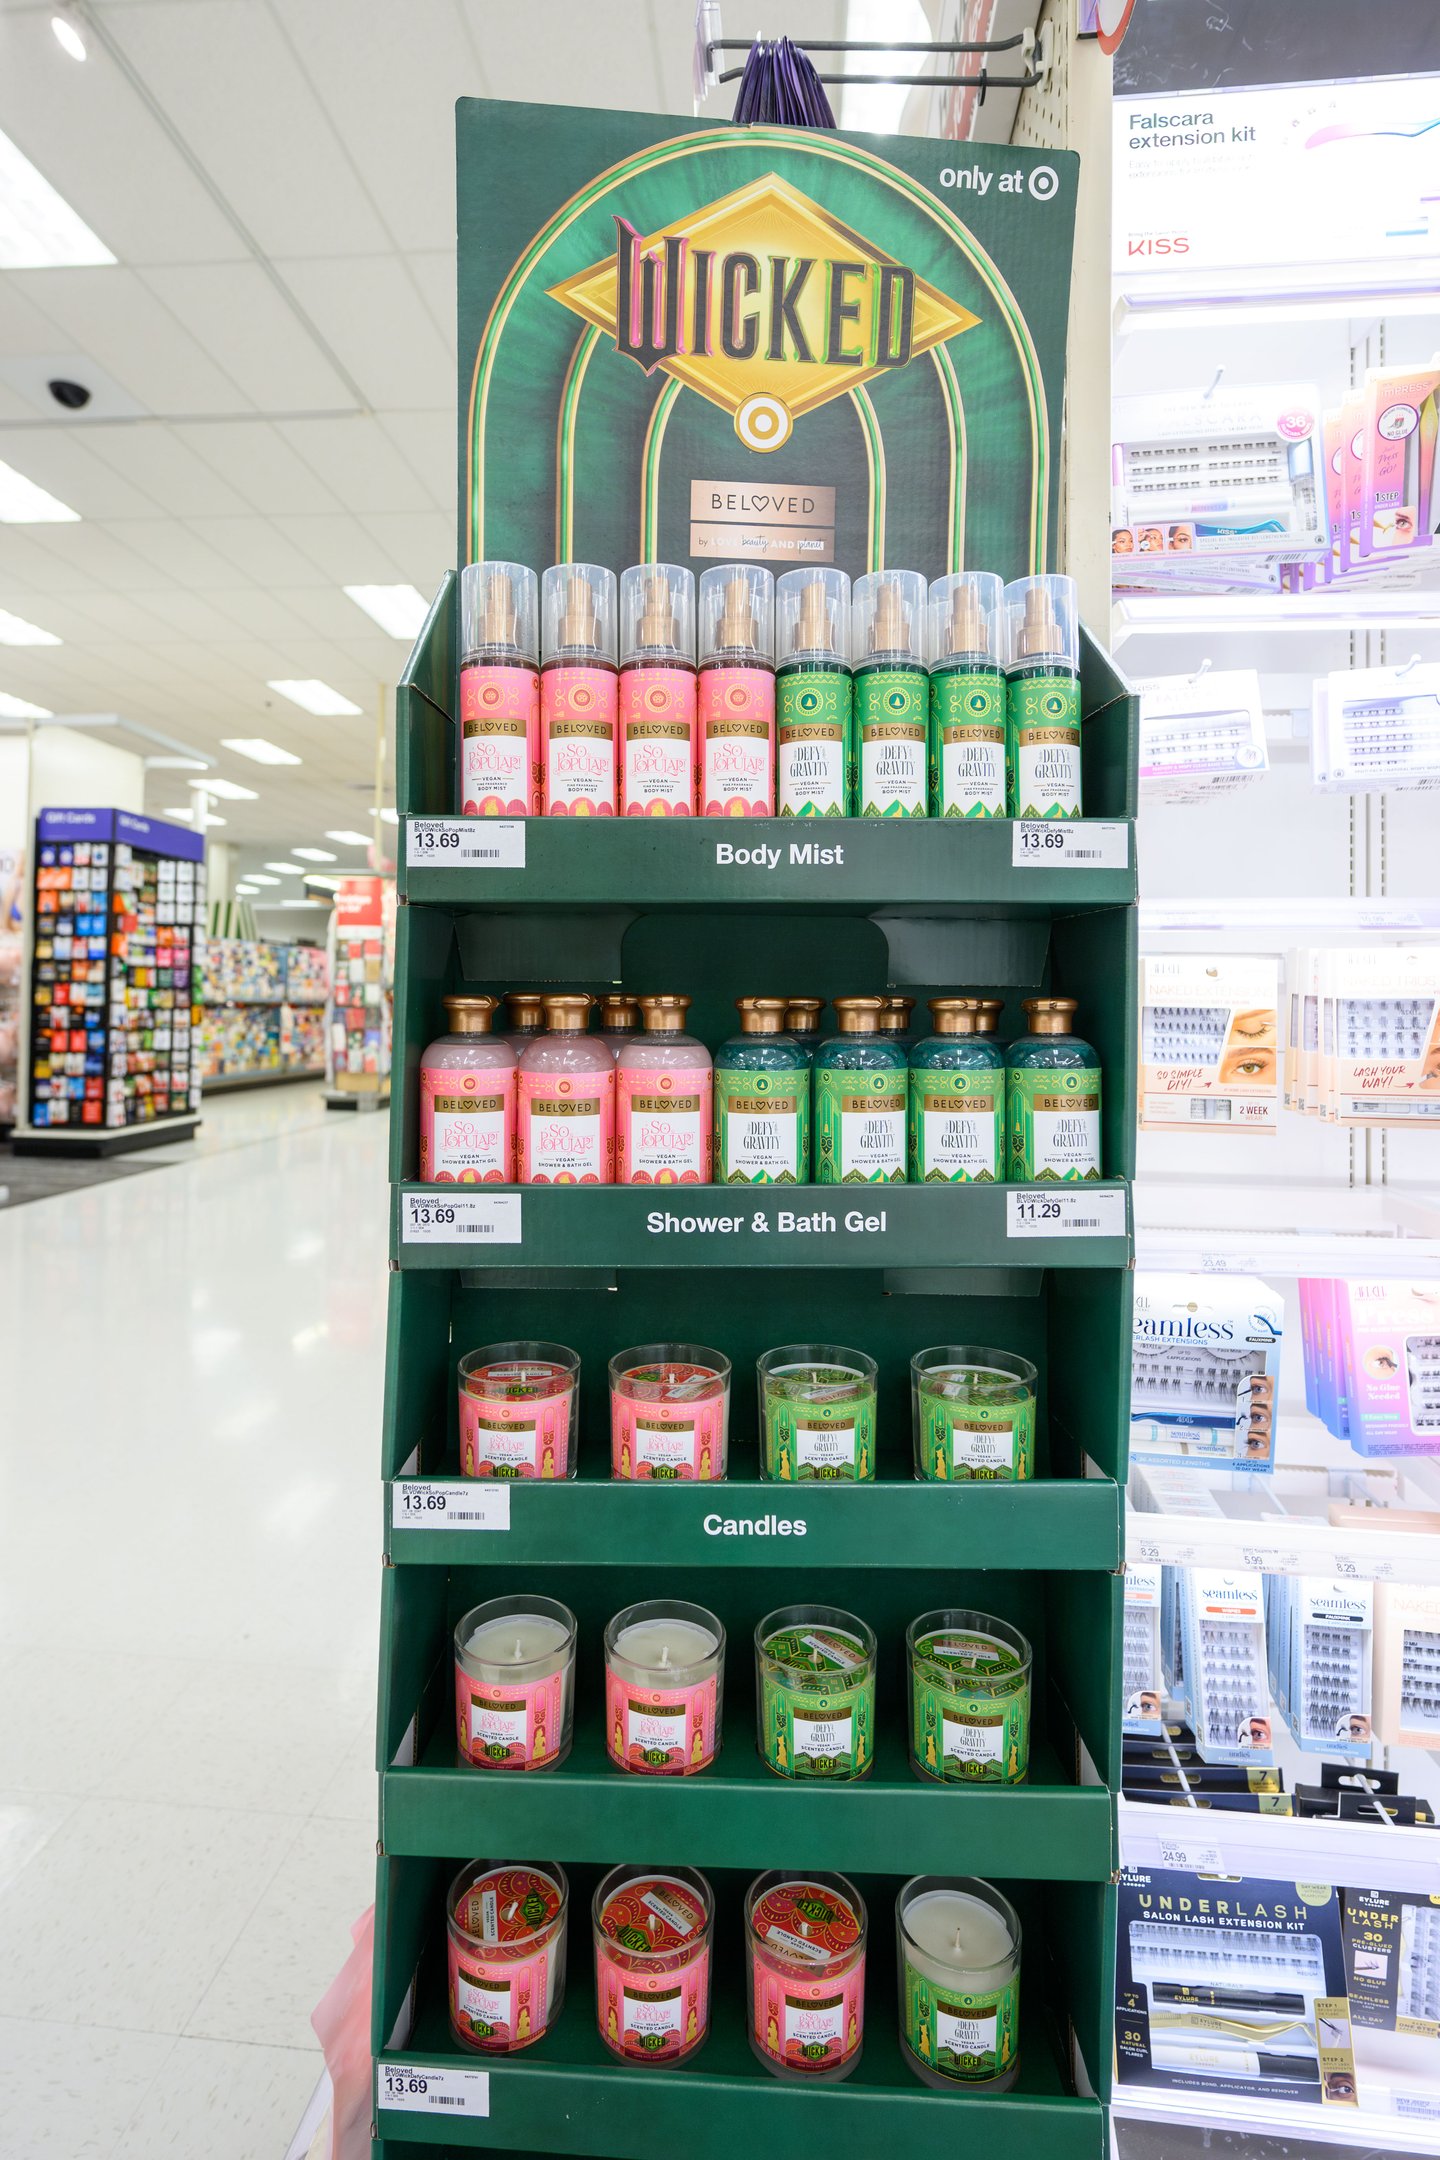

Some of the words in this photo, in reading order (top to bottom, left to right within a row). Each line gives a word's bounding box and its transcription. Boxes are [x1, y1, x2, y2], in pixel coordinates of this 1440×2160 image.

[1129, 112, 1214, 130] Falscara
[1129, 128, 1225, 150] extension
[1231, 126, 1256, 142] kit
[939, 165, 994, 195] only
[999, 170, 1023, 193] at
[1128, 237, 1190, 256] KISS
[612, 215, 915, 377] WICKED
[1286, 417, 1305, 428] 36
[698, 537, 707, 547] by
[742, 535, 768, 552] beauty
[771, 540, 794, 548] AND
[798, 538, 827, 553] planet
[477, 743, 496, 757] SO
[566, 744, 587, 758] SO
[797, 747, 821, 760] DEFY
[884, 746, 909, 759] DEFY
[966, 747, 990, 761] DEFY
[790, 761, 829, 777] GRAVITY
[876, 761, 916, 776] GRAVITY
[958, 762, 998, 777] GRAVITY
[415, 833, 459, 847] 13.69
[1022, 834, 1063, 848] 13.69
[715, 844, 782, 869] Body
[790, 843, 843, 865] Mist
[1157, 1071, 1169, 1079] SO
[1171, 1068, 1203, 1078] SIMPLE
[1353, 1067, 1379, 1077] LASH
[1381, 1066, 1406, 1076] YOUR
[1167, 1080, 1192, 1091] DIY!
[1362, 1076, 1393, 1088] WAY!
[1240, 1106, 1244, 1114] 2
[1246, 1106, 1268, 1115] WEEK
[454, 1121, 475, 1135] SO
[549, 1123, 570, 1138] SO
[750, 1121, 774, 1135] DEFY
[868, 1120, 889, 1135] DEFY
[949, 1119, 971, 1134] DEFY
[743, 1135, 781, 1149] GRAVITY
[860, 1134, 895, 1149] GRAVITY
[941, 1133, 979, 1148] GRAVITY
[411, 1209, 454, 1223] 13.69
[1018, 1204, 1060, 1218] 11.29
[647, 1212, 743, 1233] Shower
[751, 1211, 769, 1233] &
[777, 1211, 836, 1232] Bath
[844, 1211, 886, 1232] Gel
[1203, 1259, 1227, 1268] 23.49
[1133, 1317, 1234, 1340] eamless
[1162, 1336, 1208, 1345] EXTENSIONS
[404, 1496, 446, 1509] 13.69
[702, 1513, 807, 1536] Candles
[1141, 1547, 1159, 1557] 8.29
[1244, 1556, 1263, 1565] 5.99
[1337, 1564, 1355, 1573] 8.29
[1202, 1588, 1258, 1601] seamless
[1310, 1598, 1366, 1609] seamless
[1259, 1771, 1267, 1782] 7
[1272, 1797, 1279, 1807] 7
[1162, 1851, 1187, 1863] 24.99
[1139, 1894, 1307, 1920] UNDERLASH
[1359, 1896, 1389, 1906] EYLURE
[1143, 1911, 1181, 1922] SALON
[1185, 1914, 1215, 1925] LASH
[1219, 1917, 1282, 1929] EXTENSION
[1287, 1922, 1304, 1930] KIT
[1347, 1907, 1399, 1923] UNDER
[1352, 1916, 1393, 1929] LASH
[1364, 1932, 1383, 1942] 30
[1353, 1943, 1391, 1953] CLUSTERS
[1367, 1978, 1386, 1986] GLUE
[1128, 1999, 1135, 2007] 4
[1125, 2031, 1141, 2041] 30
[386, 2078, 427, 2093] 13.69
